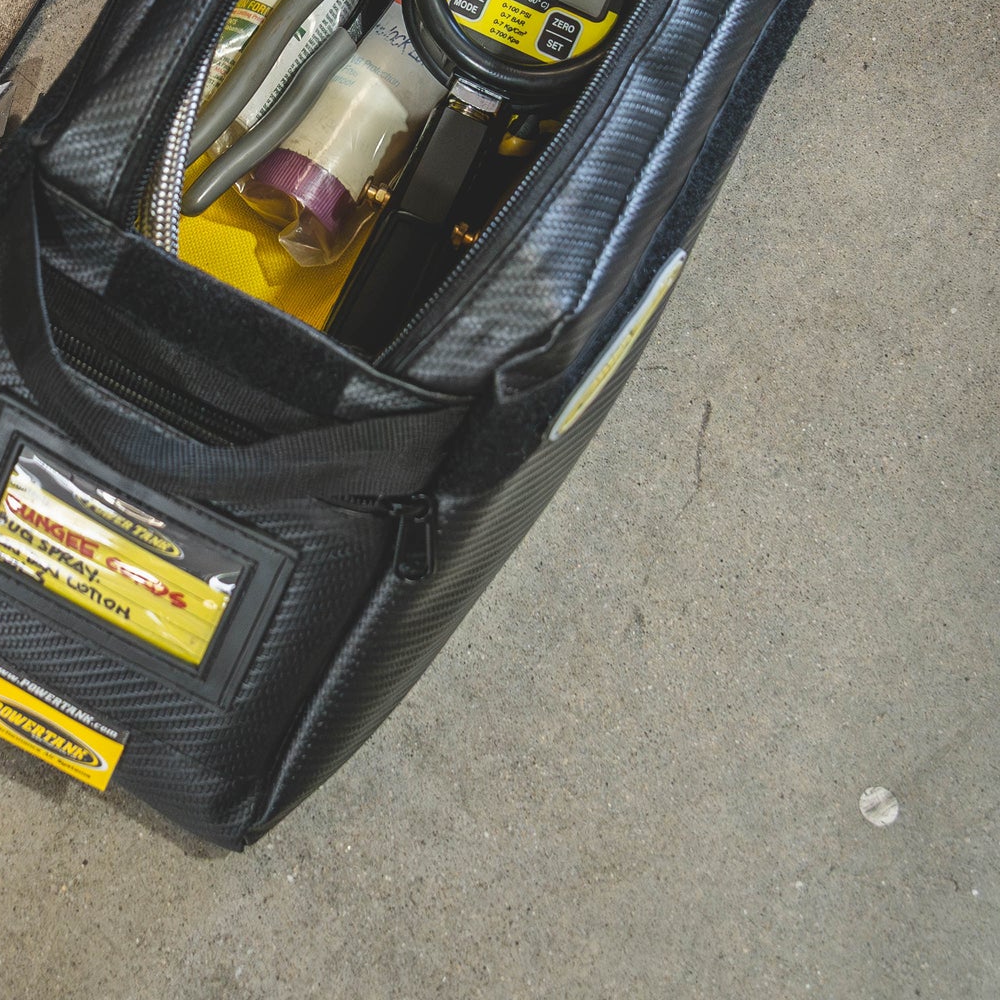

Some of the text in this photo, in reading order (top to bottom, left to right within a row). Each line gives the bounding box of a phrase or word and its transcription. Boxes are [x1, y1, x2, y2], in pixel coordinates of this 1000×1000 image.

[502, 2, 532, 19] 0-100 PSI
[493, 18, 504, 26] 0-7
[500, 11, 526, 27] 0-7 BAR
[552, 17, 576, 34] ZERO
[490, 27, 507, 39] 0-700
[546, 39, 565, 52] SET
[66, 575, 131, 620] LOTION
